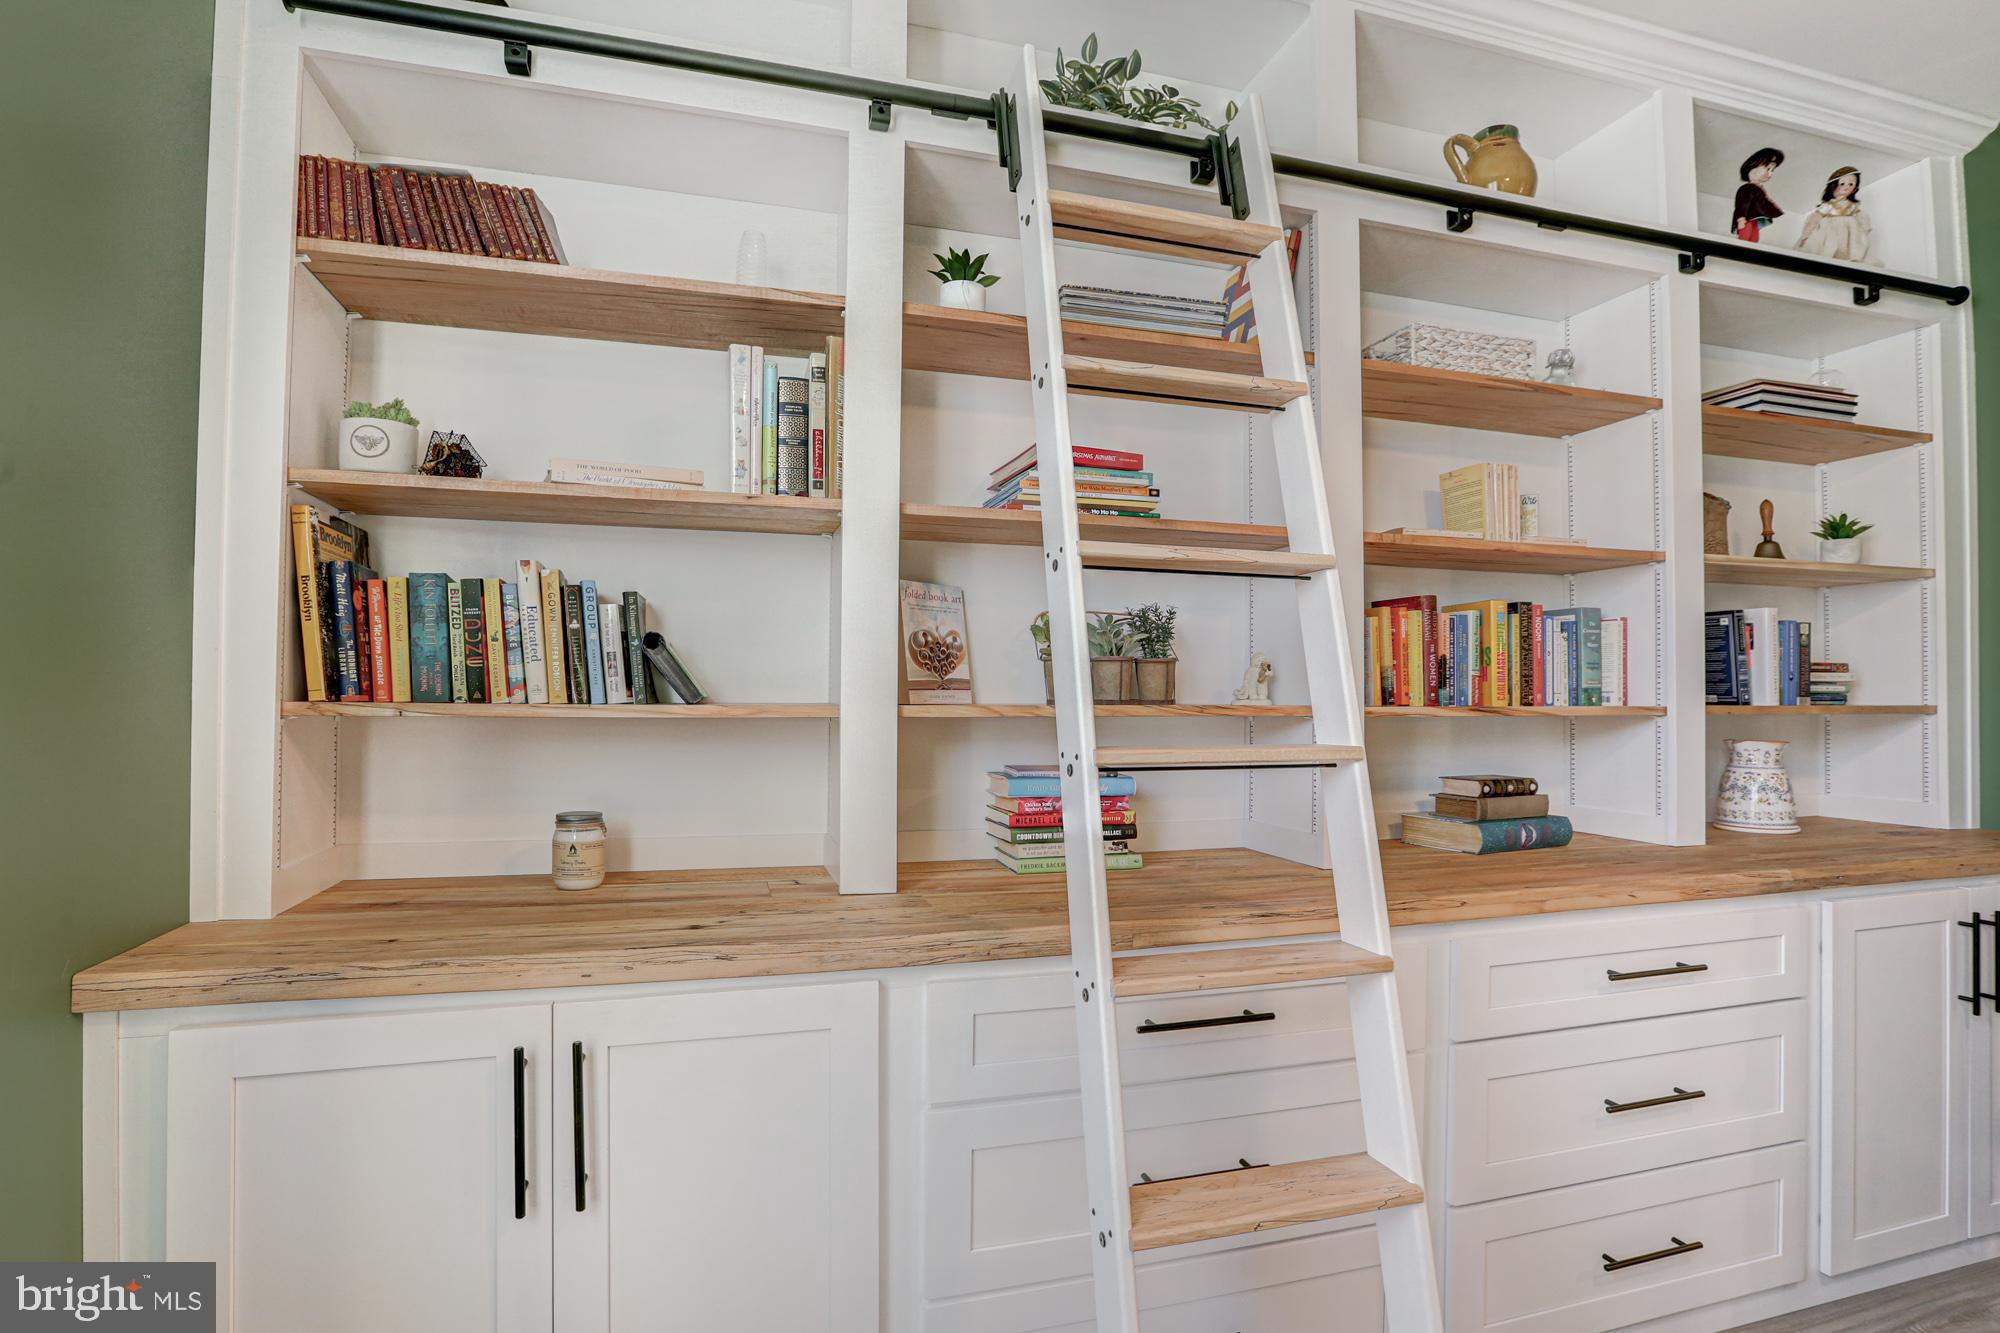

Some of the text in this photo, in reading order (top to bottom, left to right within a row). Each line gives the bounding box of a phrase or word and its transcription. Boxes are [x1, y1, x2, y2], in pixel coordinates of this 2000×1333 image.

[345, 180, 354, 225] CORIOLANUS
[375, 189, 387, 211] JULIUS
[814, 430, 823, 476] childcraft
[320, 526, 352, 554] Brooklyn
[301, 575, 312, 622] Brooklyn
[335, 573, 350, 617] Matt Haig
[393, 591, 402, 609] Life's
[450, 588, 461, 630] BLITZED
[547, 591, 558, 621] GOWN
[585, 586, 596, 629] GROUP
[628, 595, 634, 603] In
[904, 586, 926, 598] folded
[929, 591, 948, 601] book
[507, 623, 517, 648] CAKE
[526, 605, 541, 662] Educated
[1423, 608, 1431, 640] HANNAH
[1519, 604, 1528, 636] SCHWAB
[549, 624, 559, 660] JENNIFER
[1521, 637, 1528, 648] OF
[338, 647, 347, 675] LIBRARY
[346, 650, 358, 683] MIDNIGHT
